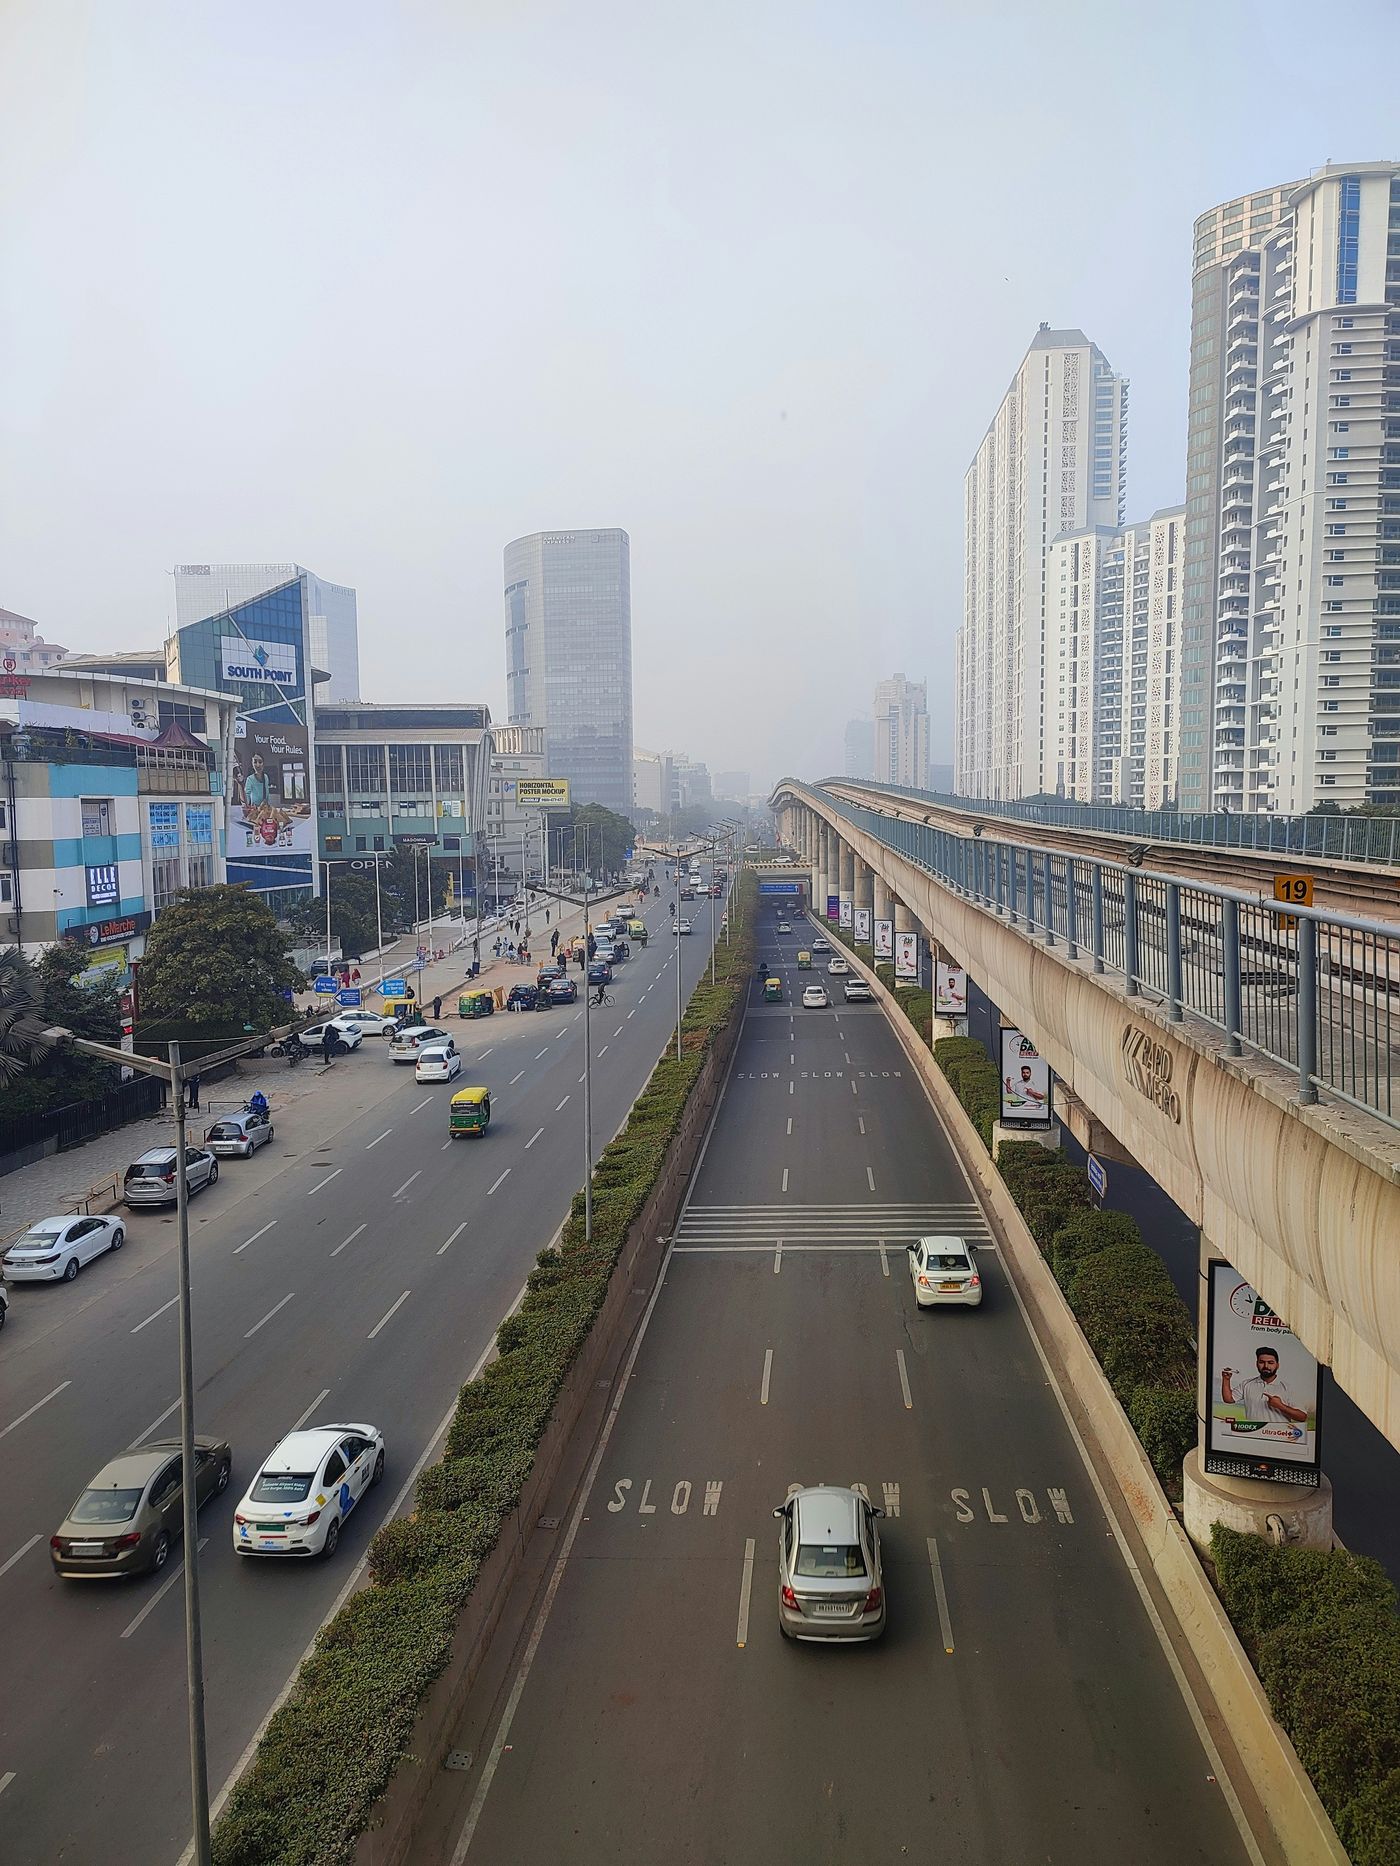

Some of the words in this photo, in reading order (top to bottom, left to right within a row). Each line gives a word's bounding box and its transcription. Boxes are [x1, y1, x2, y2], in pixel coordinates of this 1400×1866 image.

[228, 666, 262, 679] SOUTH
[264, 668, 292, 682] POINT
[254, 734, 269, 744] Your
[270, 736, 286, 744] Food.
[270, 744, 284, 753] Your
[285, 745, 304, 754] Rules.
[90, 867, 116, 884] ELLE
[91, 883, 116, 892] DECOR
[1282, 880, 1307, 899] 19
[100, 919, 136, 936] LeMarche
[1142, 1036, 1174, 1084] RAPID
[1144, 1068, 1181, 1125] METRO
[608, 1478, 724, 1515] SLOW
[950, 1487, 1075, 1524] SLOW
